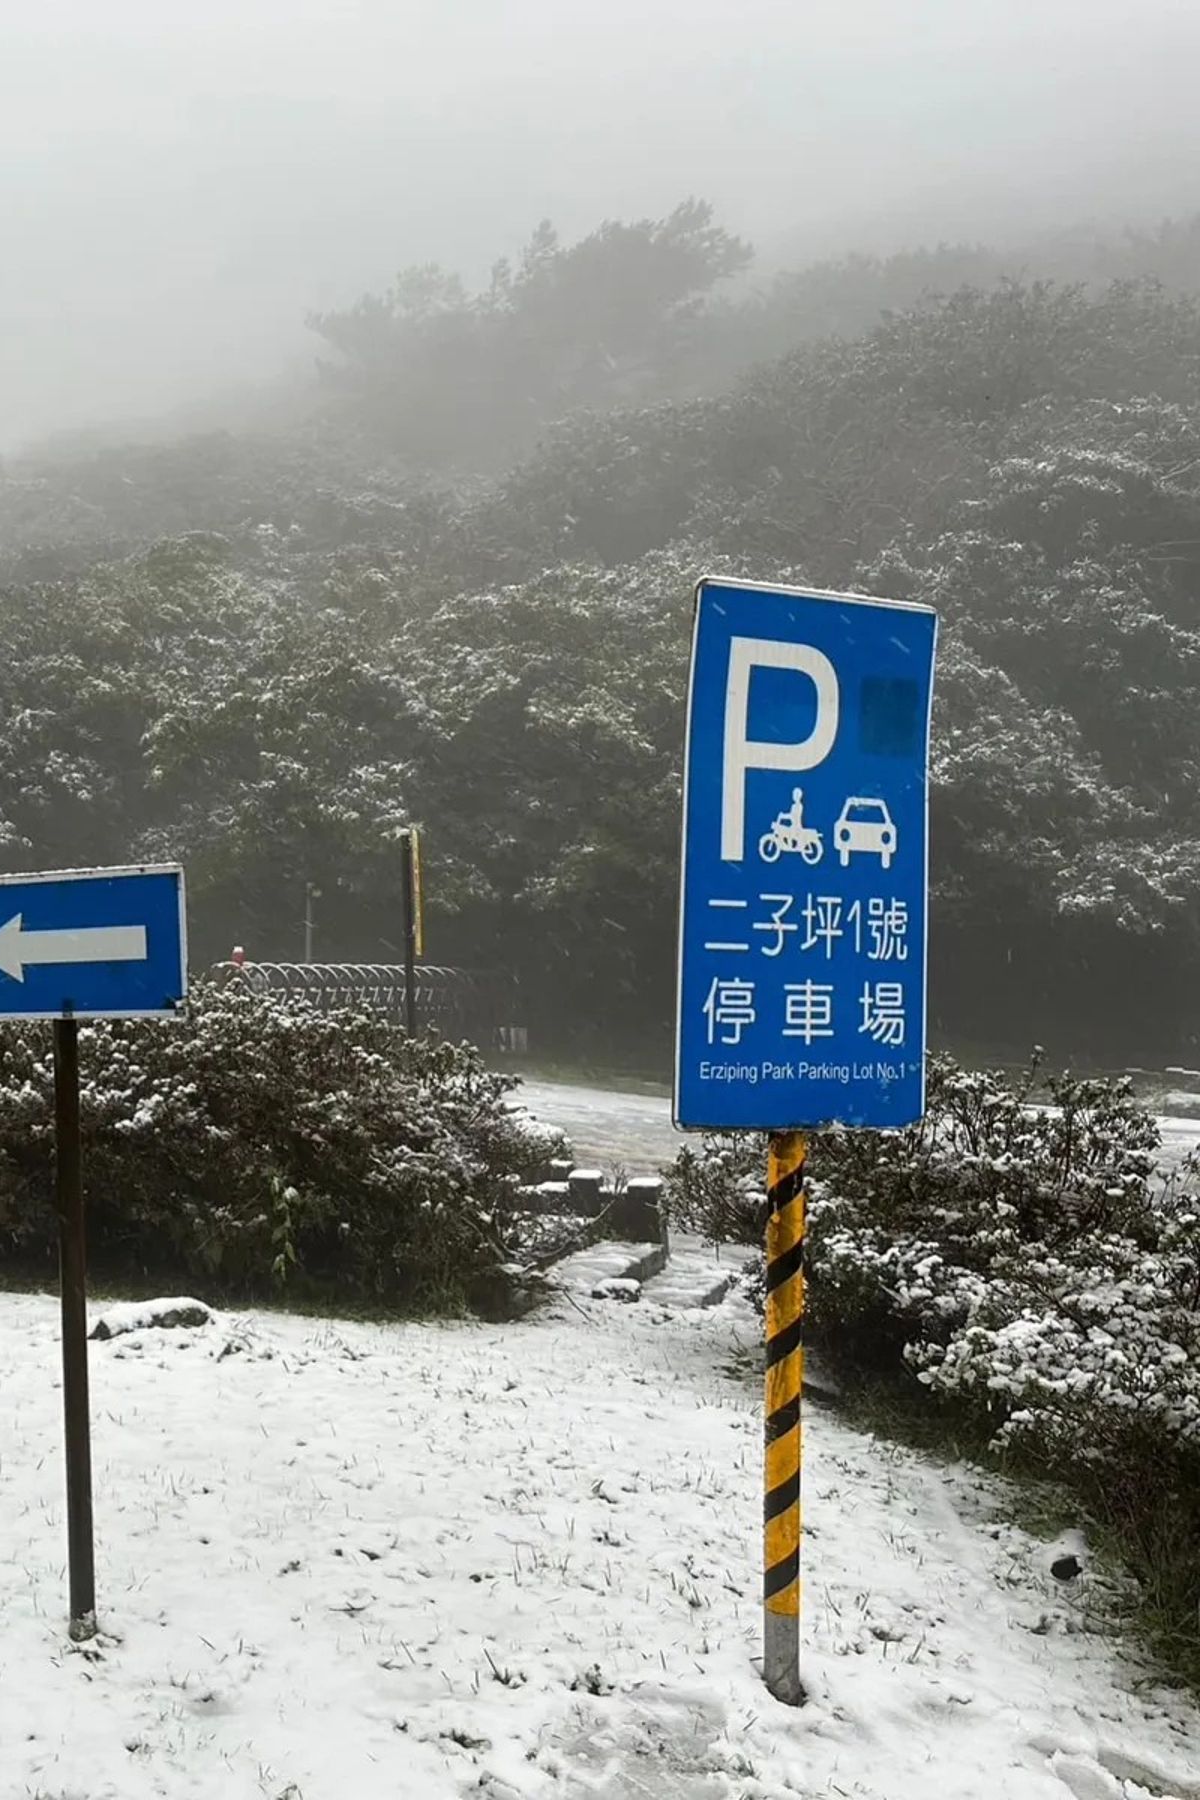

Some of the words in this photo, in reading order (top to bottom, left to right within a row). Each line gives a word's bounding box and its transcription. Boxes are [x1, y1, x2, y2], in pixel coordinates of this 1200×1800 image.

[720, 636, 840, 861] P
[704, 892, 908, 961] 二子坪1號
[702, 976, 906, 1045] 停車場
[699, 1061, 757, 1084] Erziping
[762, 1061, 795, 1080] Park
[799, 1061, 850, 1084] Parking
[853, 1062, 873, 1080] Lot
[877, 1061, 906, 1080] No.1
